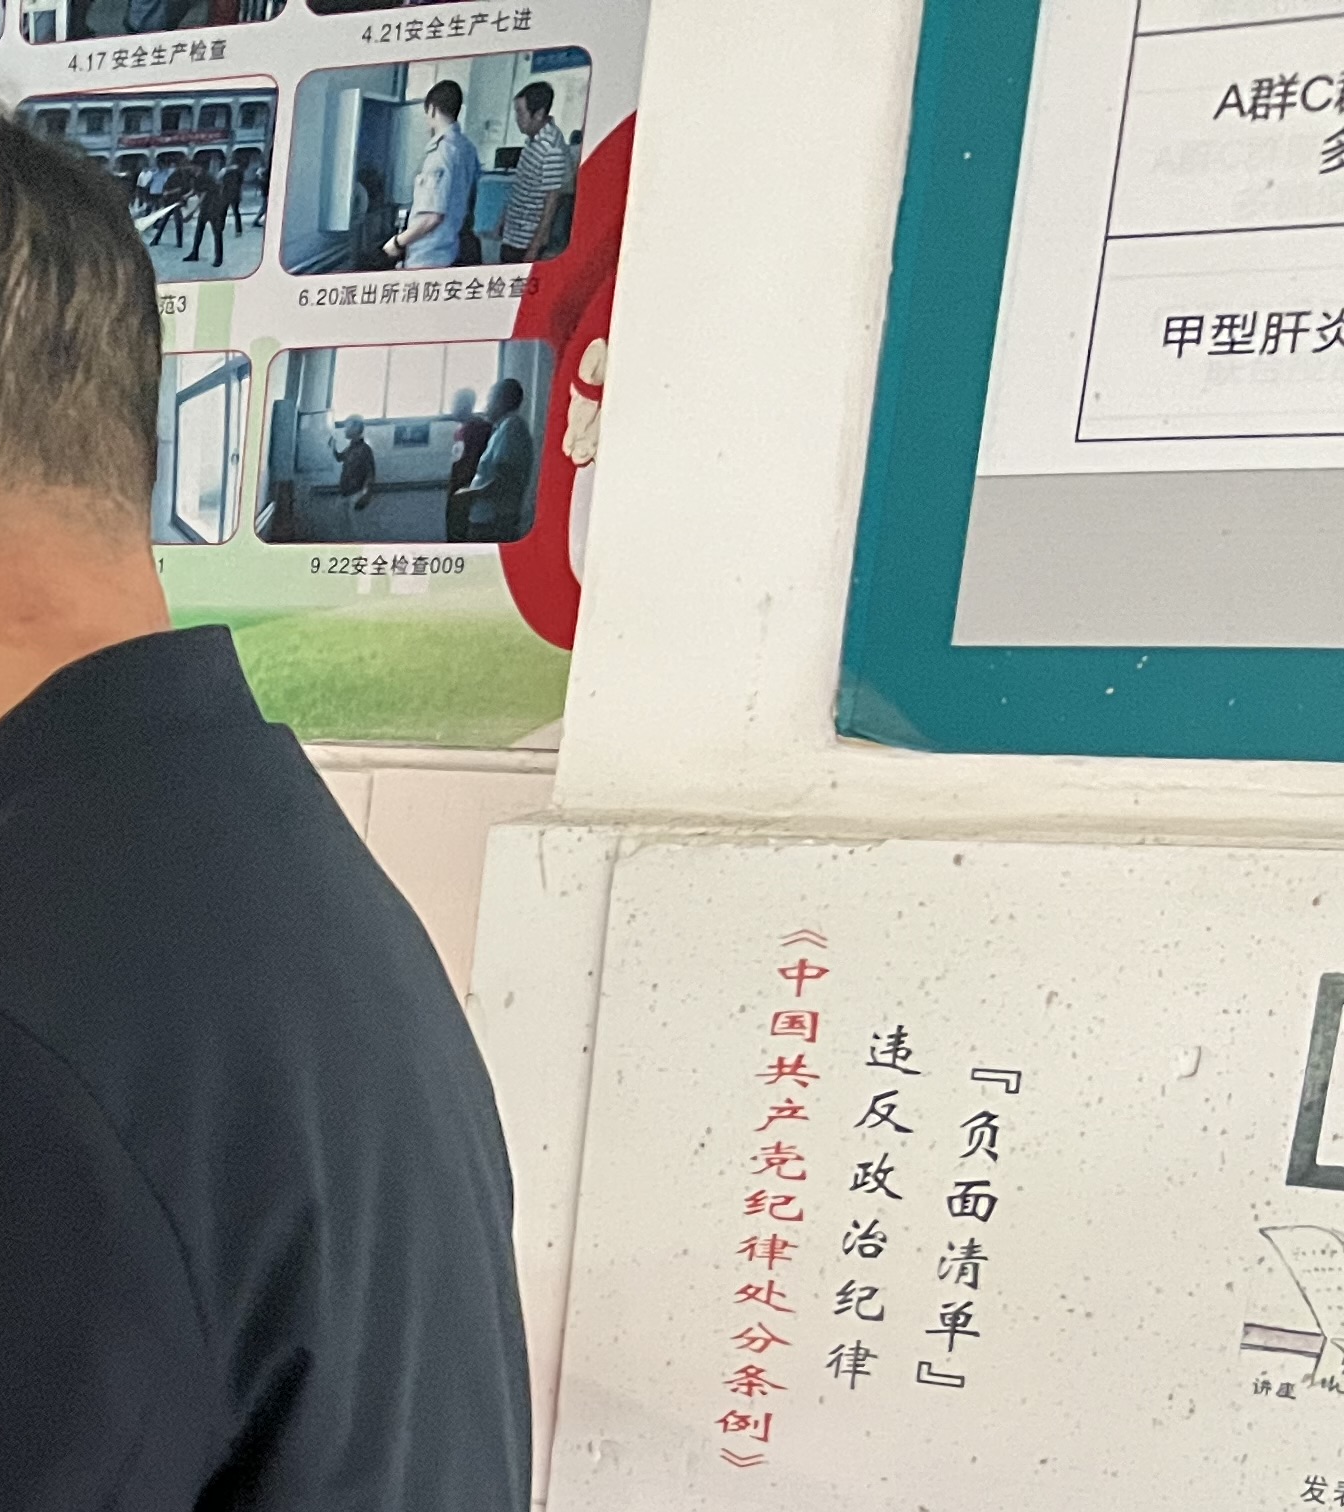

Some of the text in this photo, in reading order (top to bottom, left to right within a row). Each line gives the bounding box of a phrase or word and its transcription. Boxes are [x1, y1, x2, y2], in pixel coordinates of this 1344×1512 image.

[361, 9, 532, 44] 4.21安全生产七进
[67, 39, 228, 73] 4.17 安全生产检查
[1213, 72, 1344, 121] A群C
[298, 276, 540, 308] 6.20派出所消防安全检查3
[1162, 306, 1344, 359] 甲型肝炎
[310, 556, 465, 576] 9.22安全检查009
[714, 928, 830, 1468] 《中国共产党纪律处分条例》
[825, 1024, 922, 1391] 违反政治纪律
